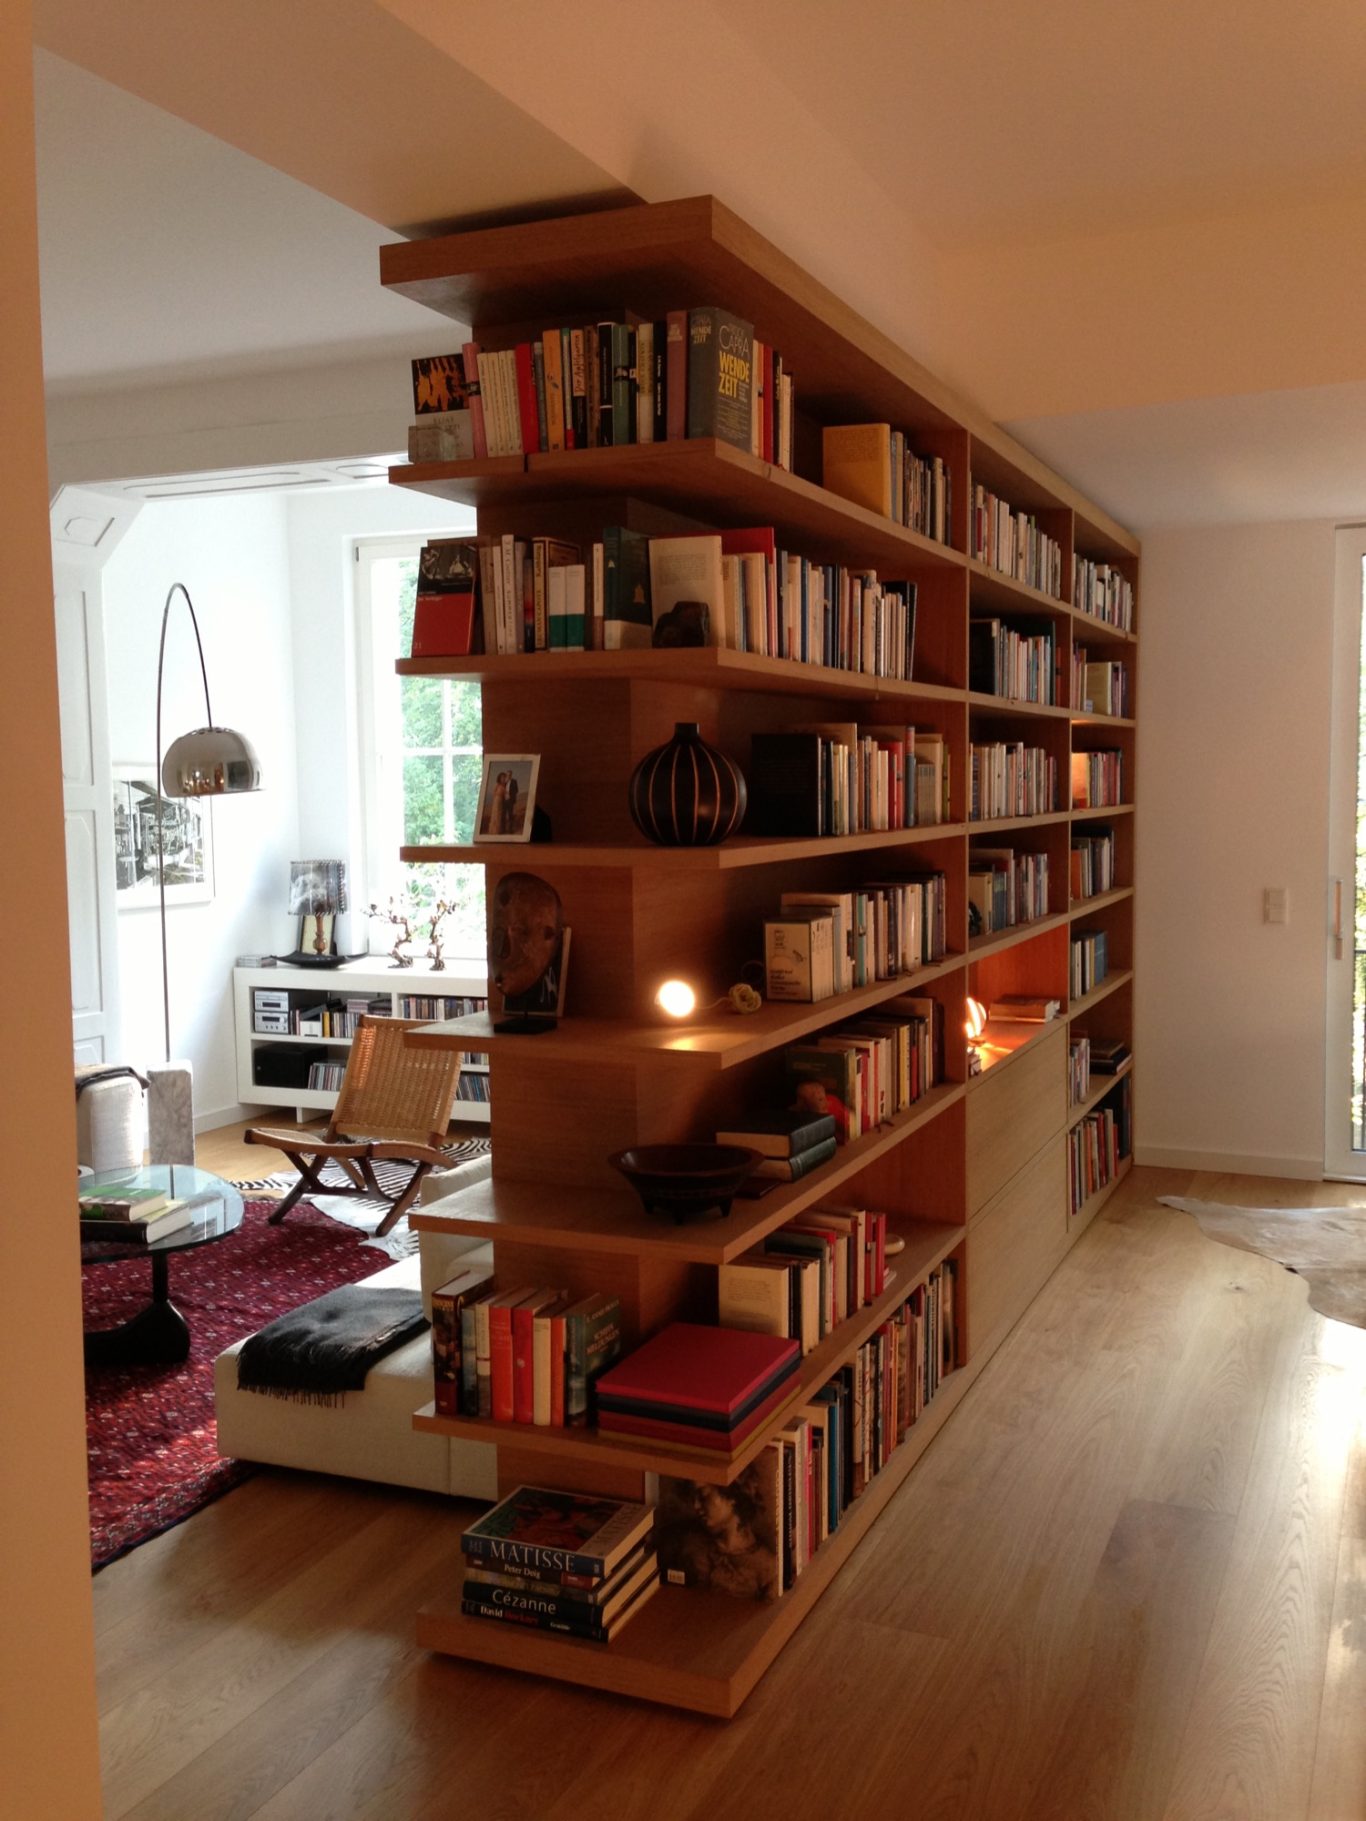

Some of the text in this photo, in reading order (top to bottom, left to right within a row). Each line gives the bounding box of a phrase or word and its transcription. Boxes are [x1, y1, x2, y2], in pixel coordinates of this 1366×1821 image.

[719, 350, 750, 383] WENDE
[718, 371, 738, 399] ZEIT
[489, 1541, 577, 1573] MATISSE
[504, 1563, 522, 1576] Peter
[480, 1605, 503, 1618] David
[492, 1589, 558, 1615] Cézanne
